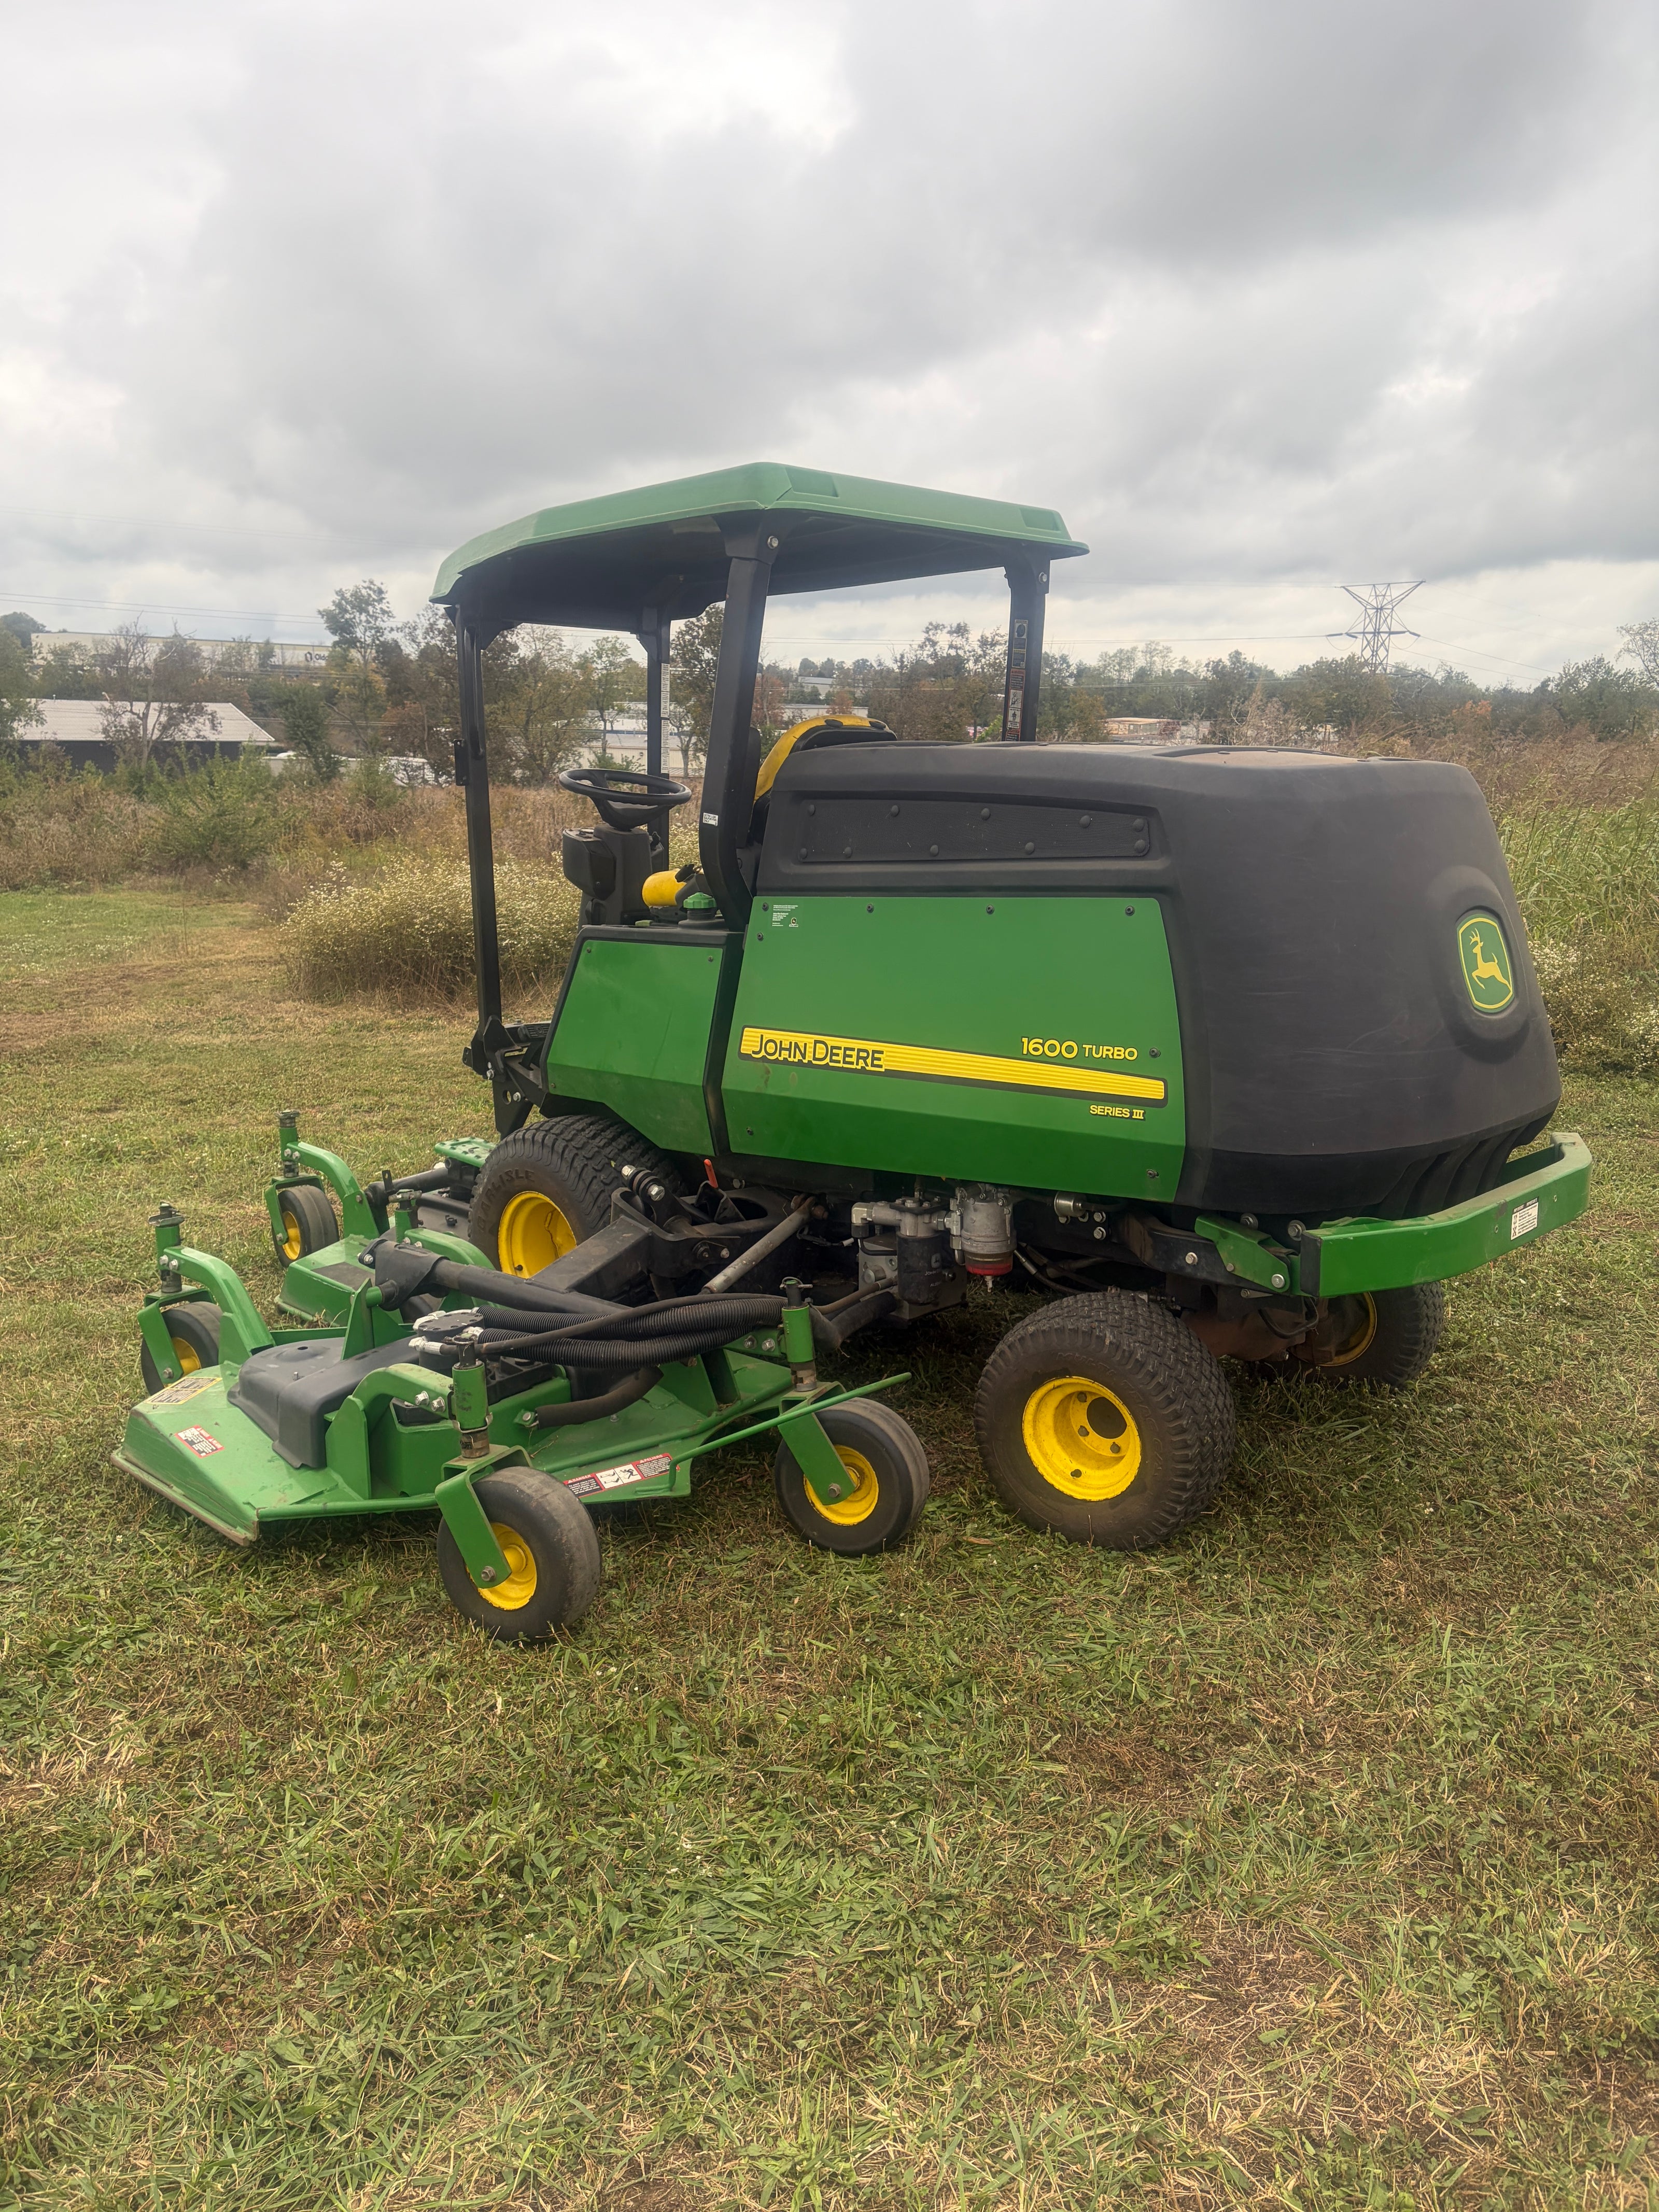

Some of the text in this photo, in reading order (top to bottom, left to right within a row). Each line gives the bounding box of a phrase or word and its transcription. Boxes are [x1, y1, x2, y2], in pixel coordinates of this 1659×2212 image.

[752, 1034, 884, 1069] JOHN DEERE
[1021, 1037, 1138, 1061] 1600 TURBO
[1090, 1105, 1145, 1120] SERIES III
[476, 1168, 536, 1232] CARLISLE
